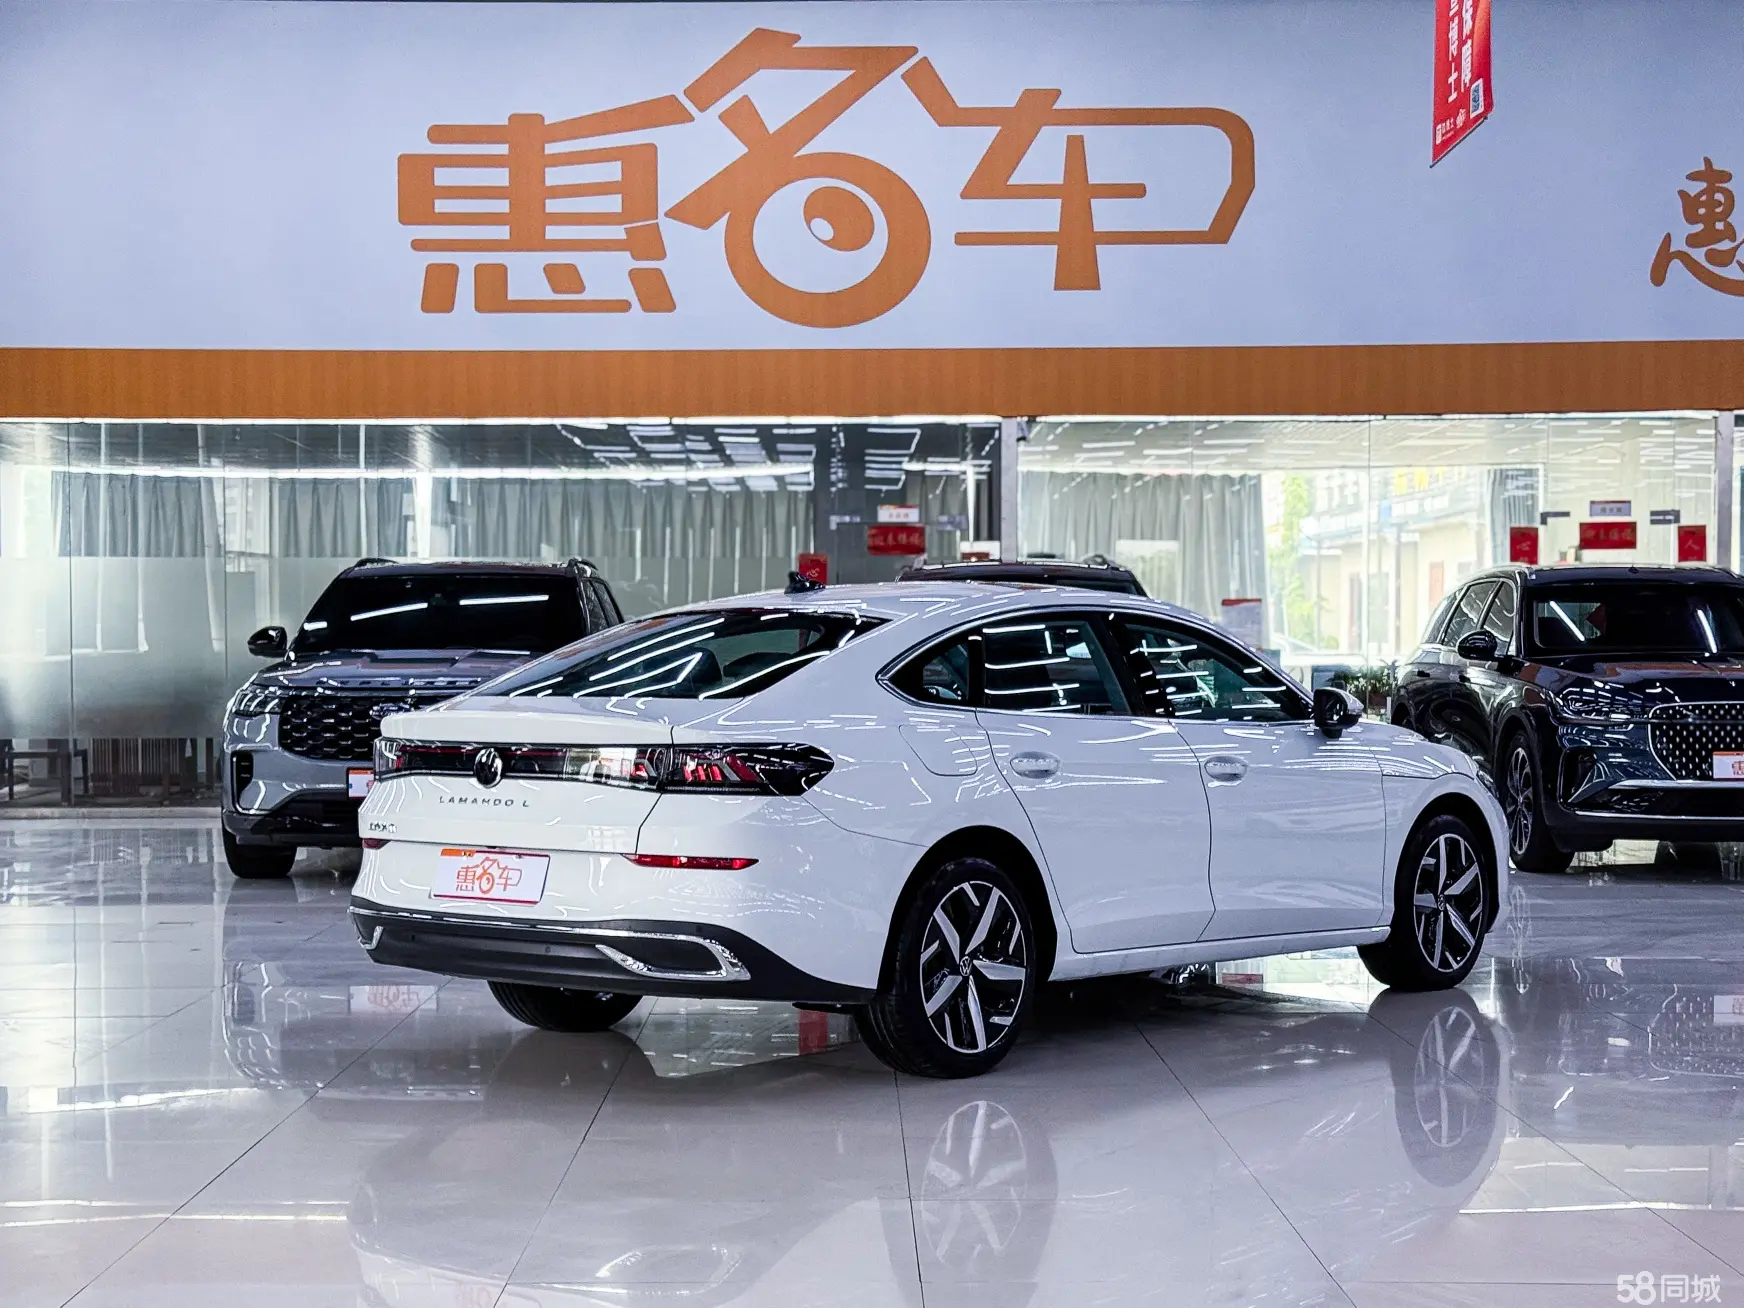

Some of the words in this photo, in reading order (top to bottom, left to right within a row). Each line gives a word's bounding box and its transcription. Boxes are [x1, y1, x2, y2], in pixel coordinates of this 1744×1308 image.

[397, 27, 1256, 329] 惠名车
[439, 795, 514, 807] LAMANDO
[522, 799, 530, 808] L
[455, 856, 523, 895] 惠名车
